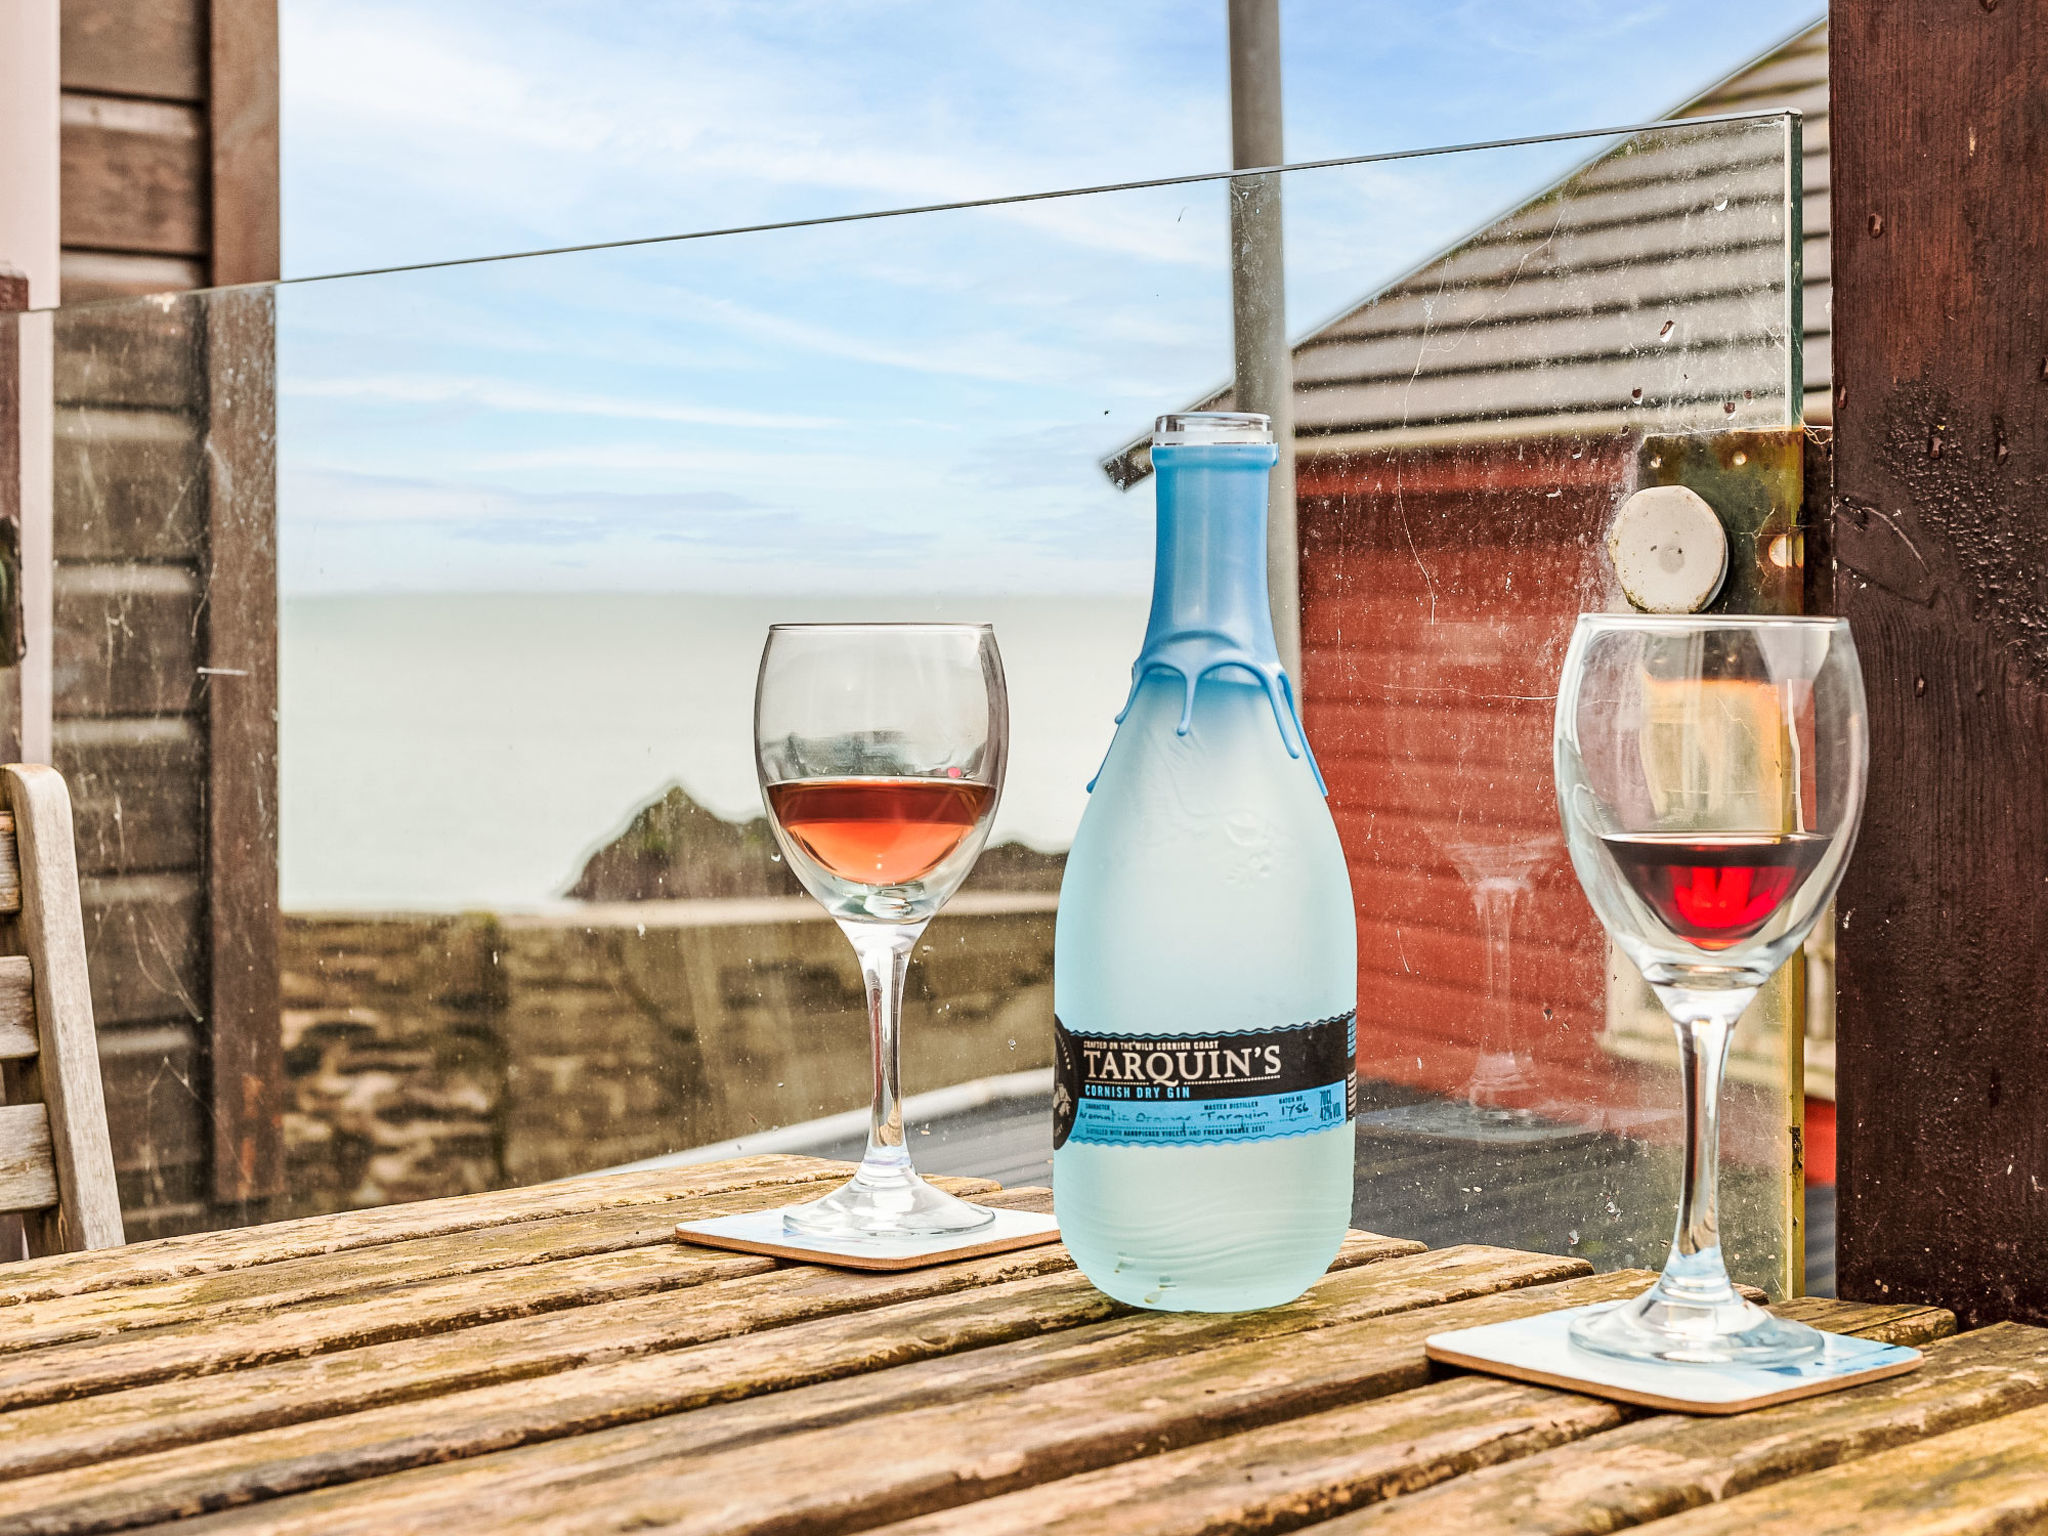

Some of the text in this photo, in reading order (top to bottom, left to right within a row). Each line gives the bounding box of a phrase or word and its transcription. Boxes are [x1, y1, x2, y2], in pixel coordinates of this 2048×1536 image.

[1120, 1042, 1132, 1050] THE
[1133, 1042, 1153, 1050] WILD
[1156, 1042, 1191, 1050] CORNISH
[1194, 1041, 1219, 1049] COAST
[1083, 1045, 1281, 1087] TARQUIN'S
[1085, 1085, 1190, 1098] CORNISH DRY GIN
[1204, 1101, 1258, 1110] MASTER DISTILLER
[1203, 1128, 1224, 1136] FRESH
[1251, 1125, 1266, 1133] ZEST
